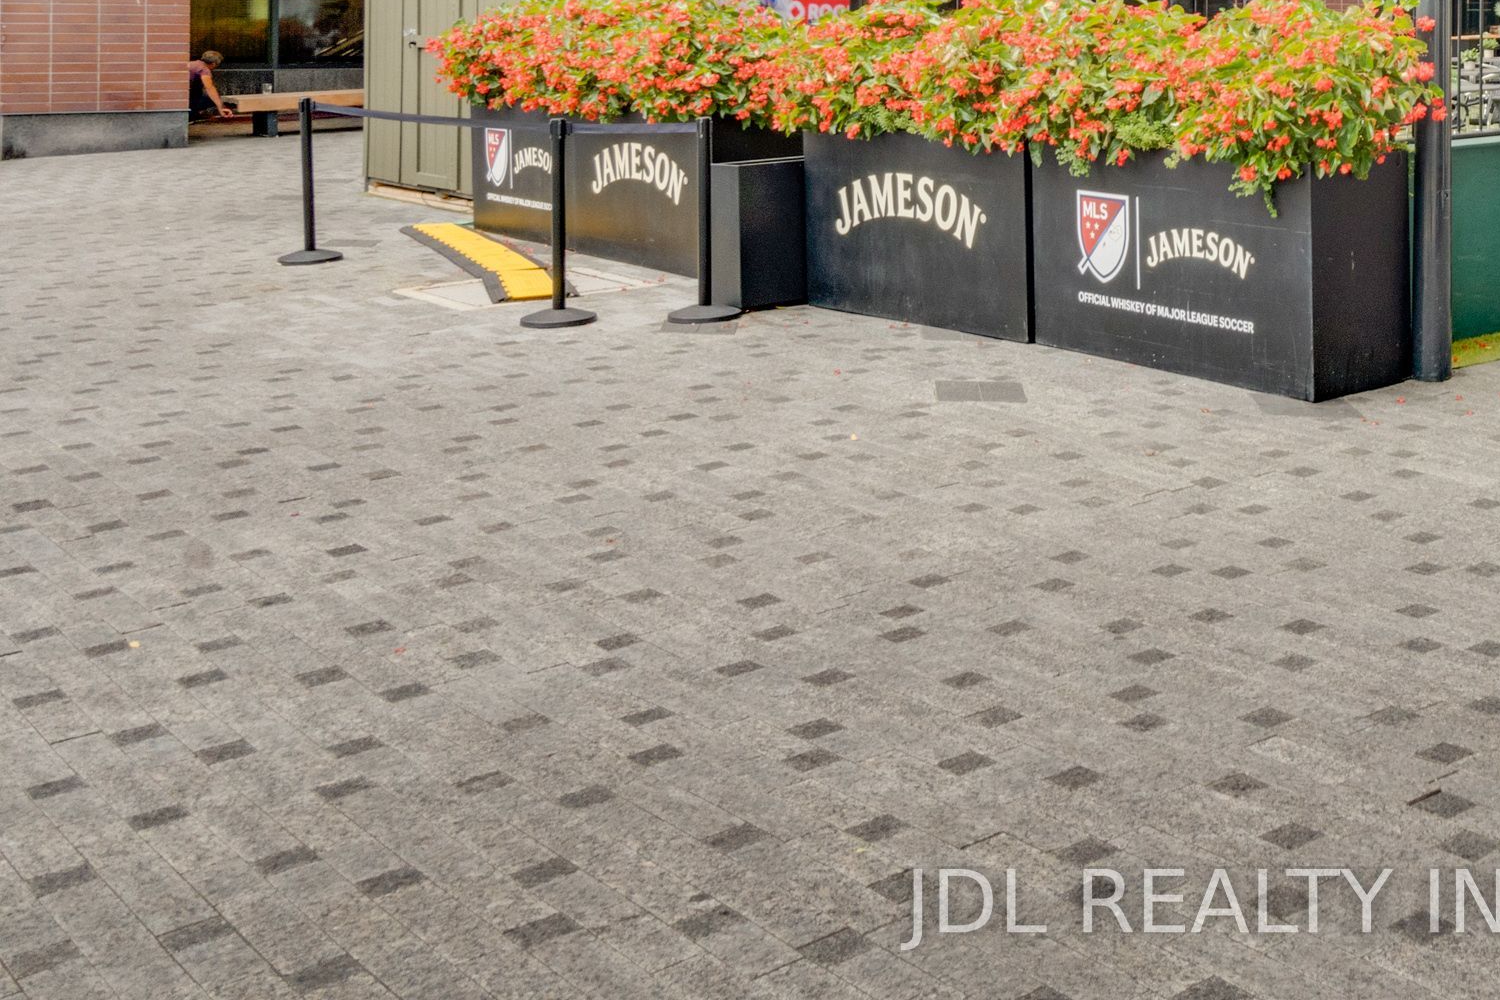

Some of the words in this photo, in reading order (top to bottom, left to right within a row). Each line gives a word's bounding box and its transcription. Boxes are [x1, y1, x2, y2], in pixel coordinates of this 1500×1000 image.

[514, 147, 553, 174] JAMESO
[592, 142, 688, 206] JAMESON
[835, 172, 985, 249] JAMESON
[1082, 200, 1109, 221] MLS
[1146, 228, 1254, 280] JAMESON
[1078, 291, 1111, 307] OFFICIAL
[1111, 297, 1145, 314] WHISKEY
[1145, 303, 1157, 316] OF
[1157, 305, 1186, 321] MAJOR
[1186, 310, 1218, 327] LEAGUE
[1219, 316, 1254, 334] SOCCER
